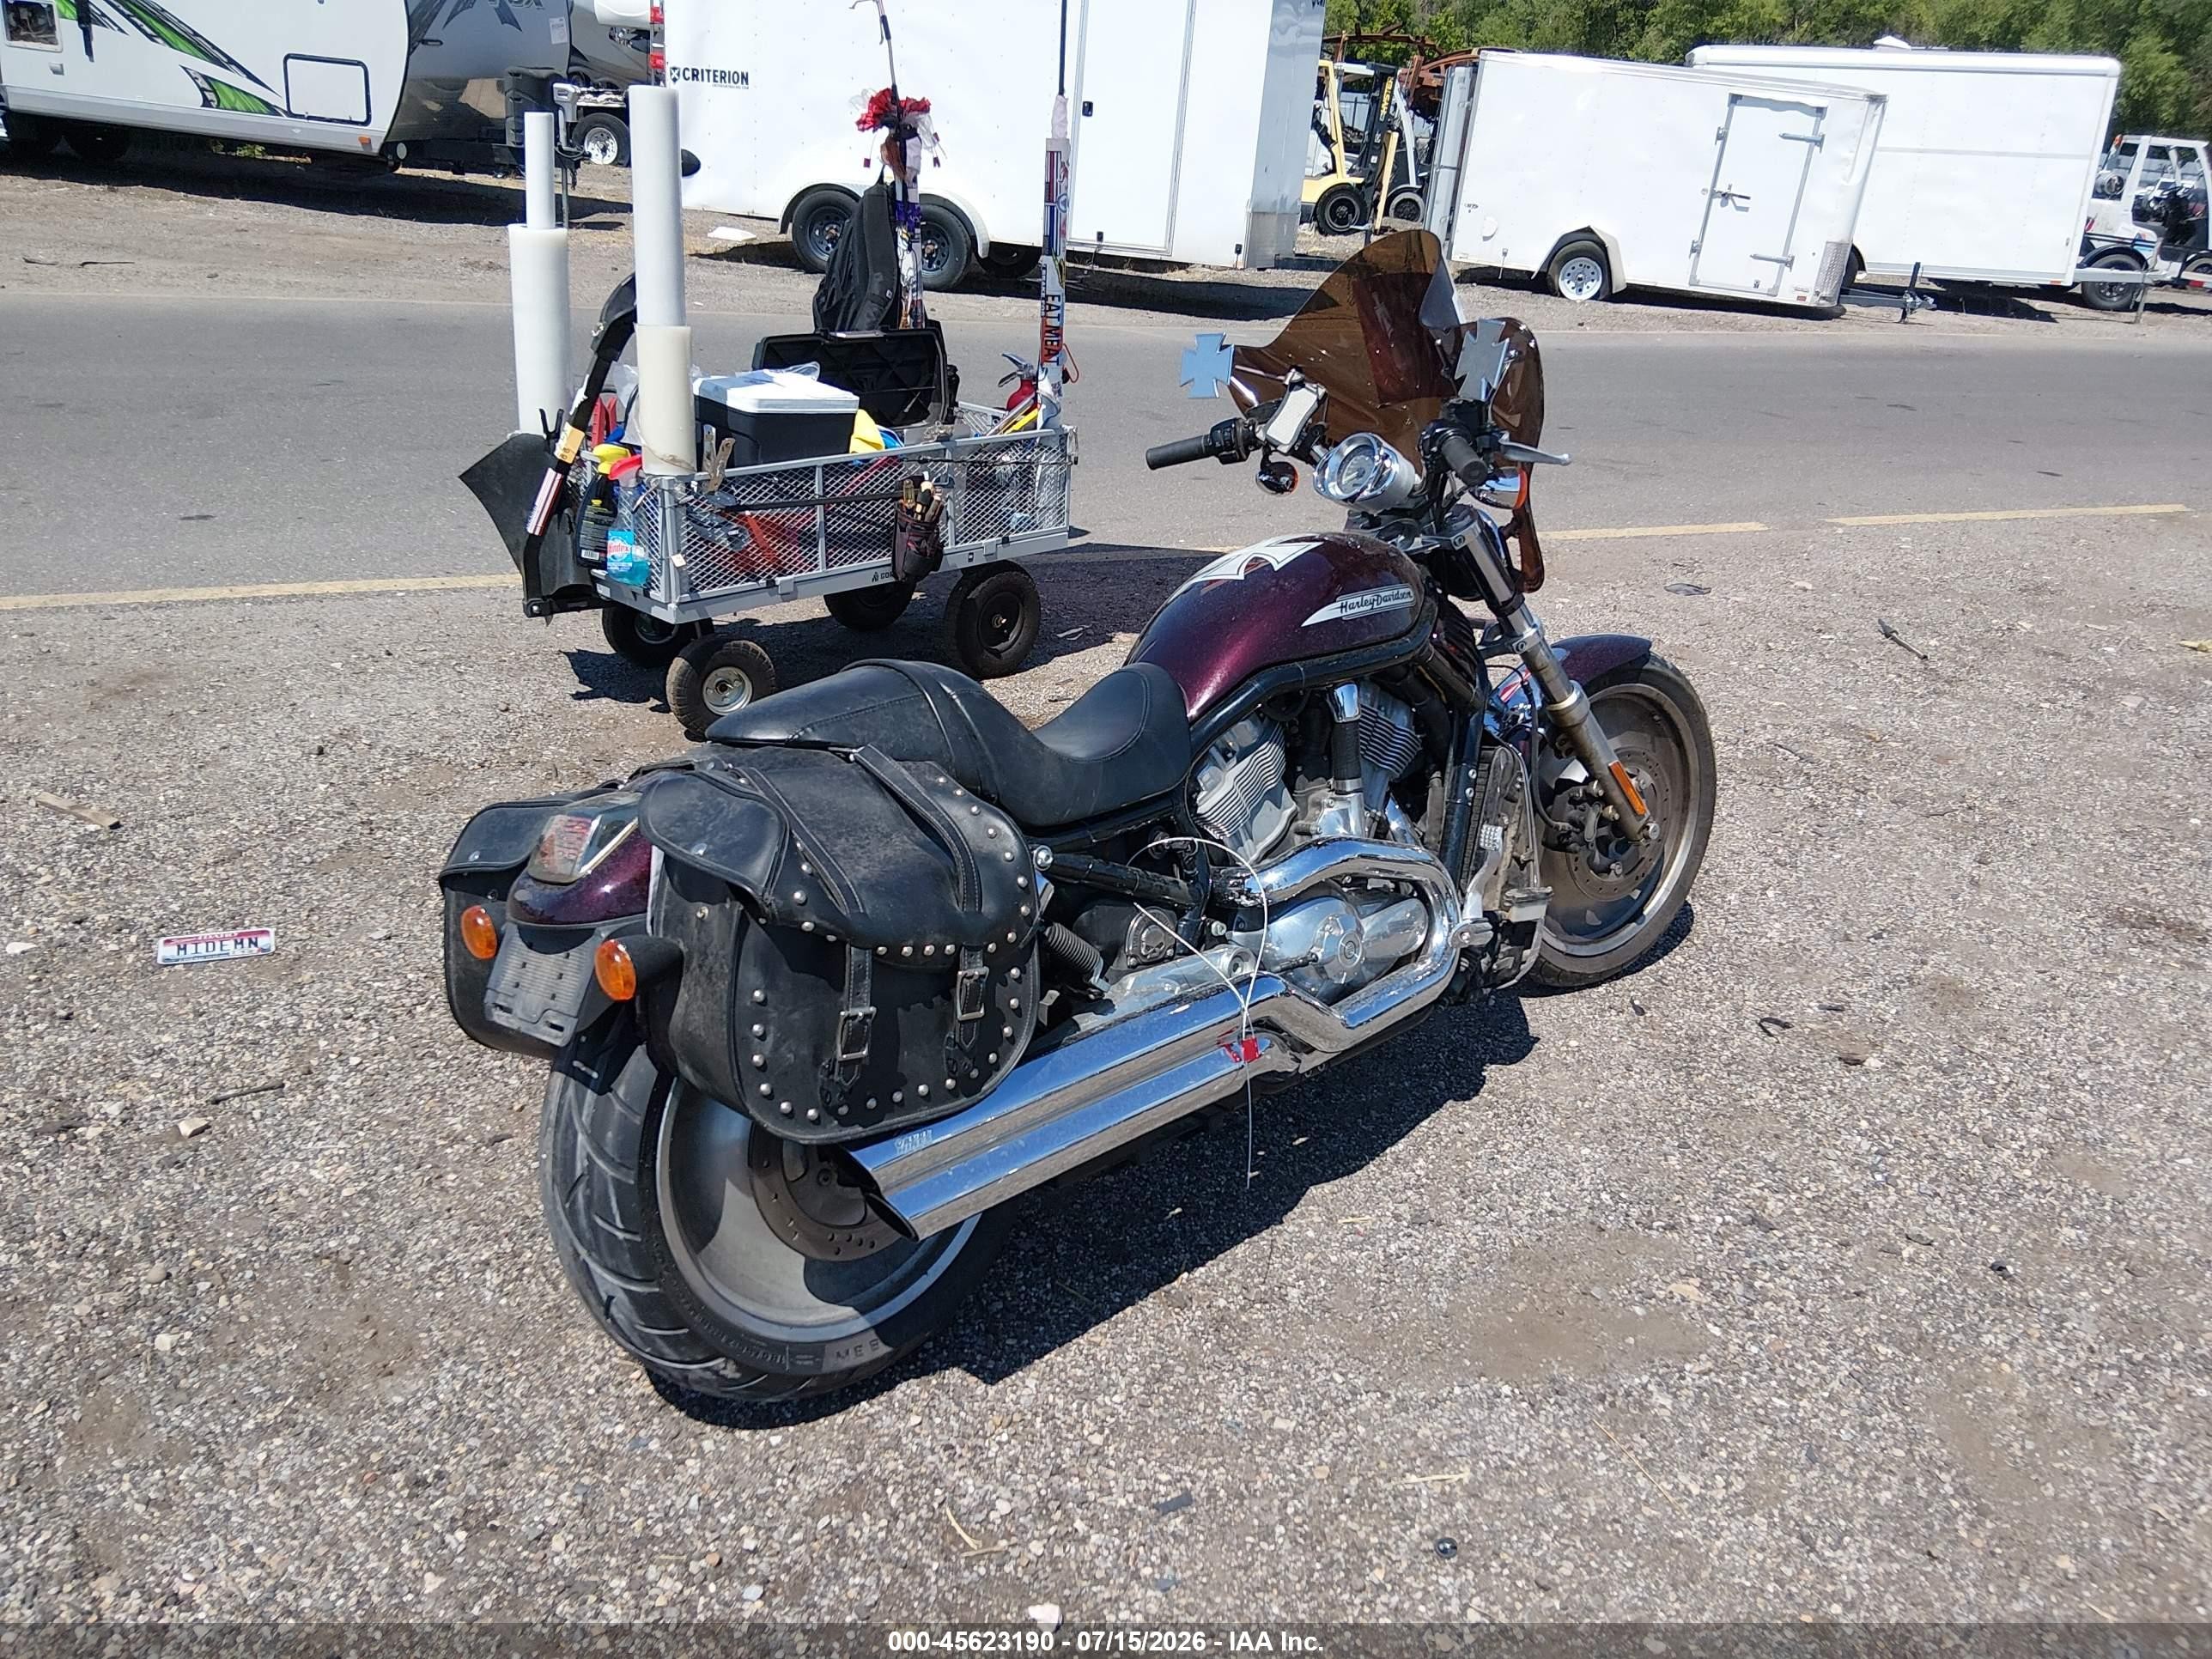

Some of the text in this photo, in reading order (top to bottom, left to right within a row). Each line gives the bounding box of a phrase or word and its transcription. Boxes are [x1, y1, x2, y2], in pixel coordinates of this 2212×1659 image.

[683, 67, 749, 85] CRITERION
[1045, 295, 1061, 322] EAT
[1043, 325, 1060, 366] MEAT
[177, 937, 258, 957] MIDEMN
